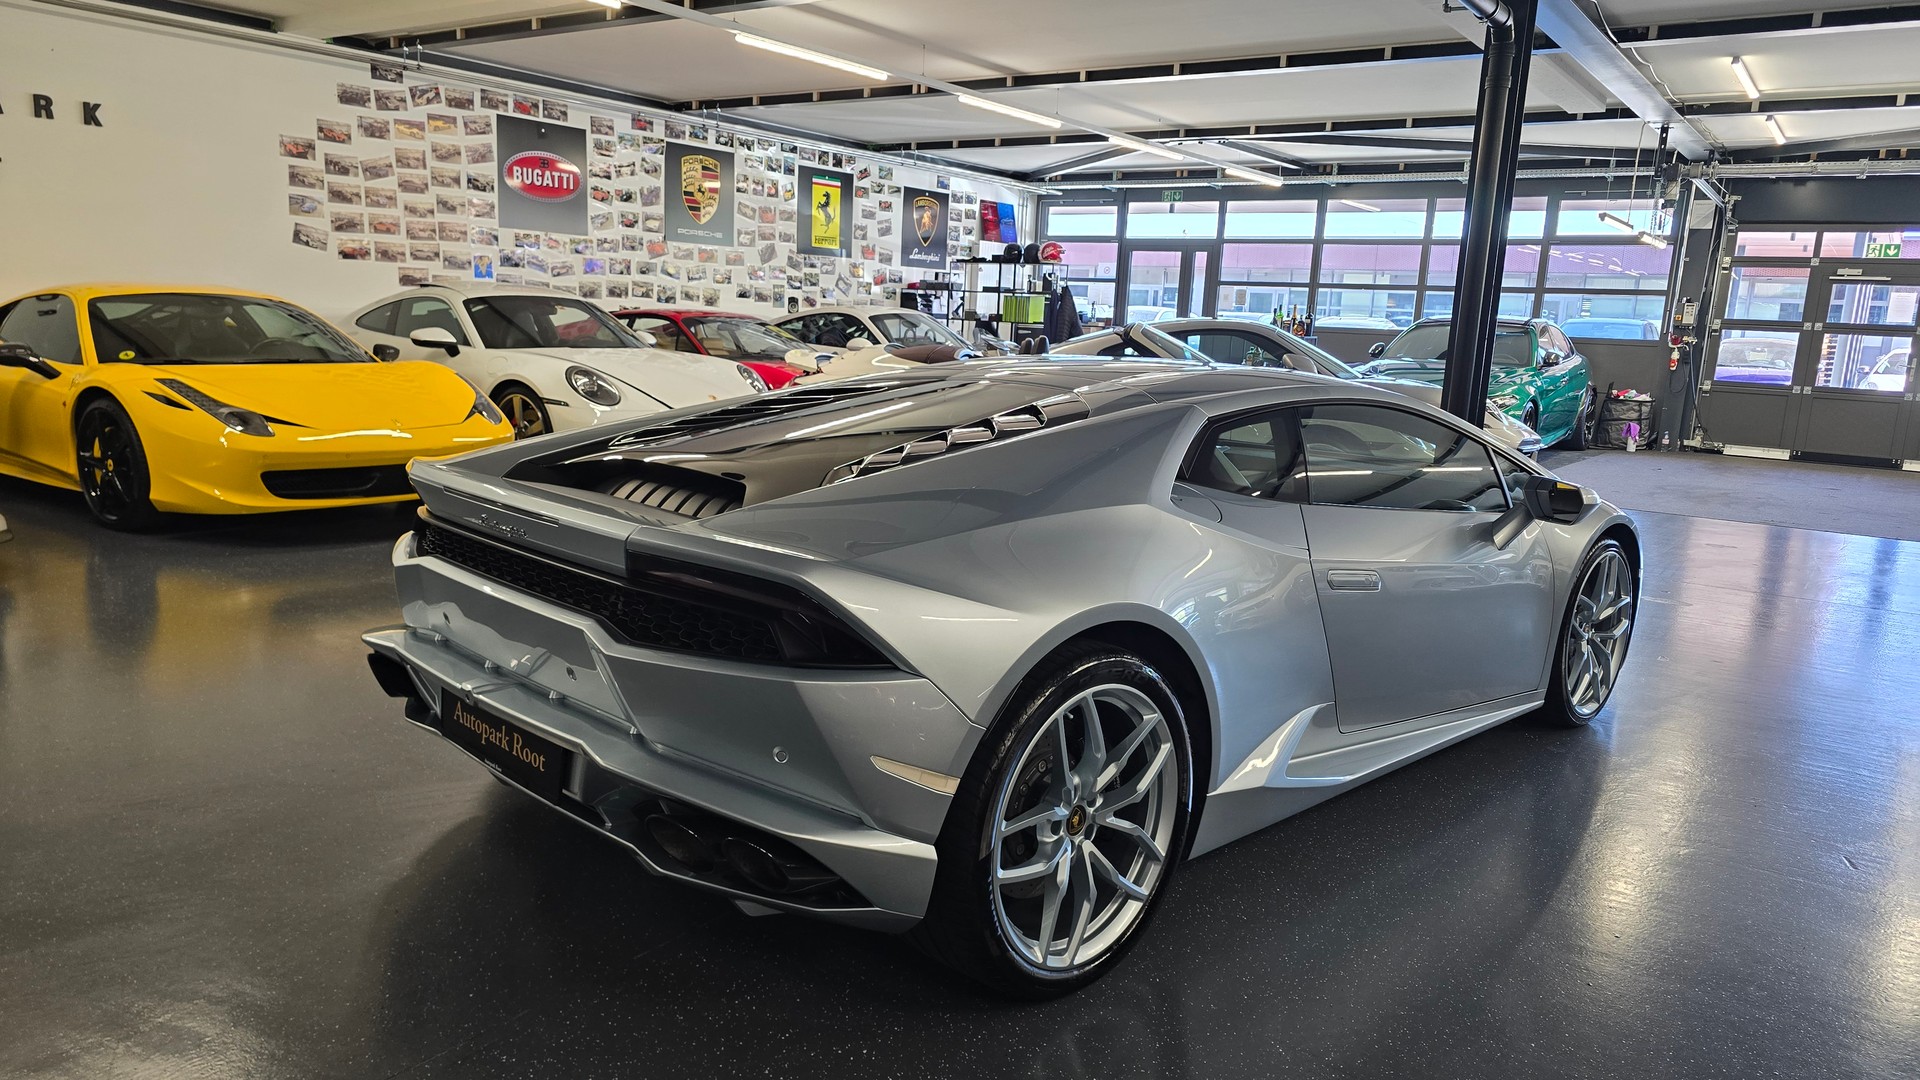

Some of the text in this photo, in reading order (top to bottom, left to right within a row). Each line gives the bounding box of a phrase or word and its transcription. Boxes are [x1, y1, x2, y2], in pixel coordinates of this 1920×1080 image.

[0, 93, 103, 127] RK
[513, 166, 575, 190] BUGATTI
[677, 228, 723, 239] PORSCHE
[814, 235, 838, 246] Ferrari
[453, 701, 546, 772] Autopark Root
